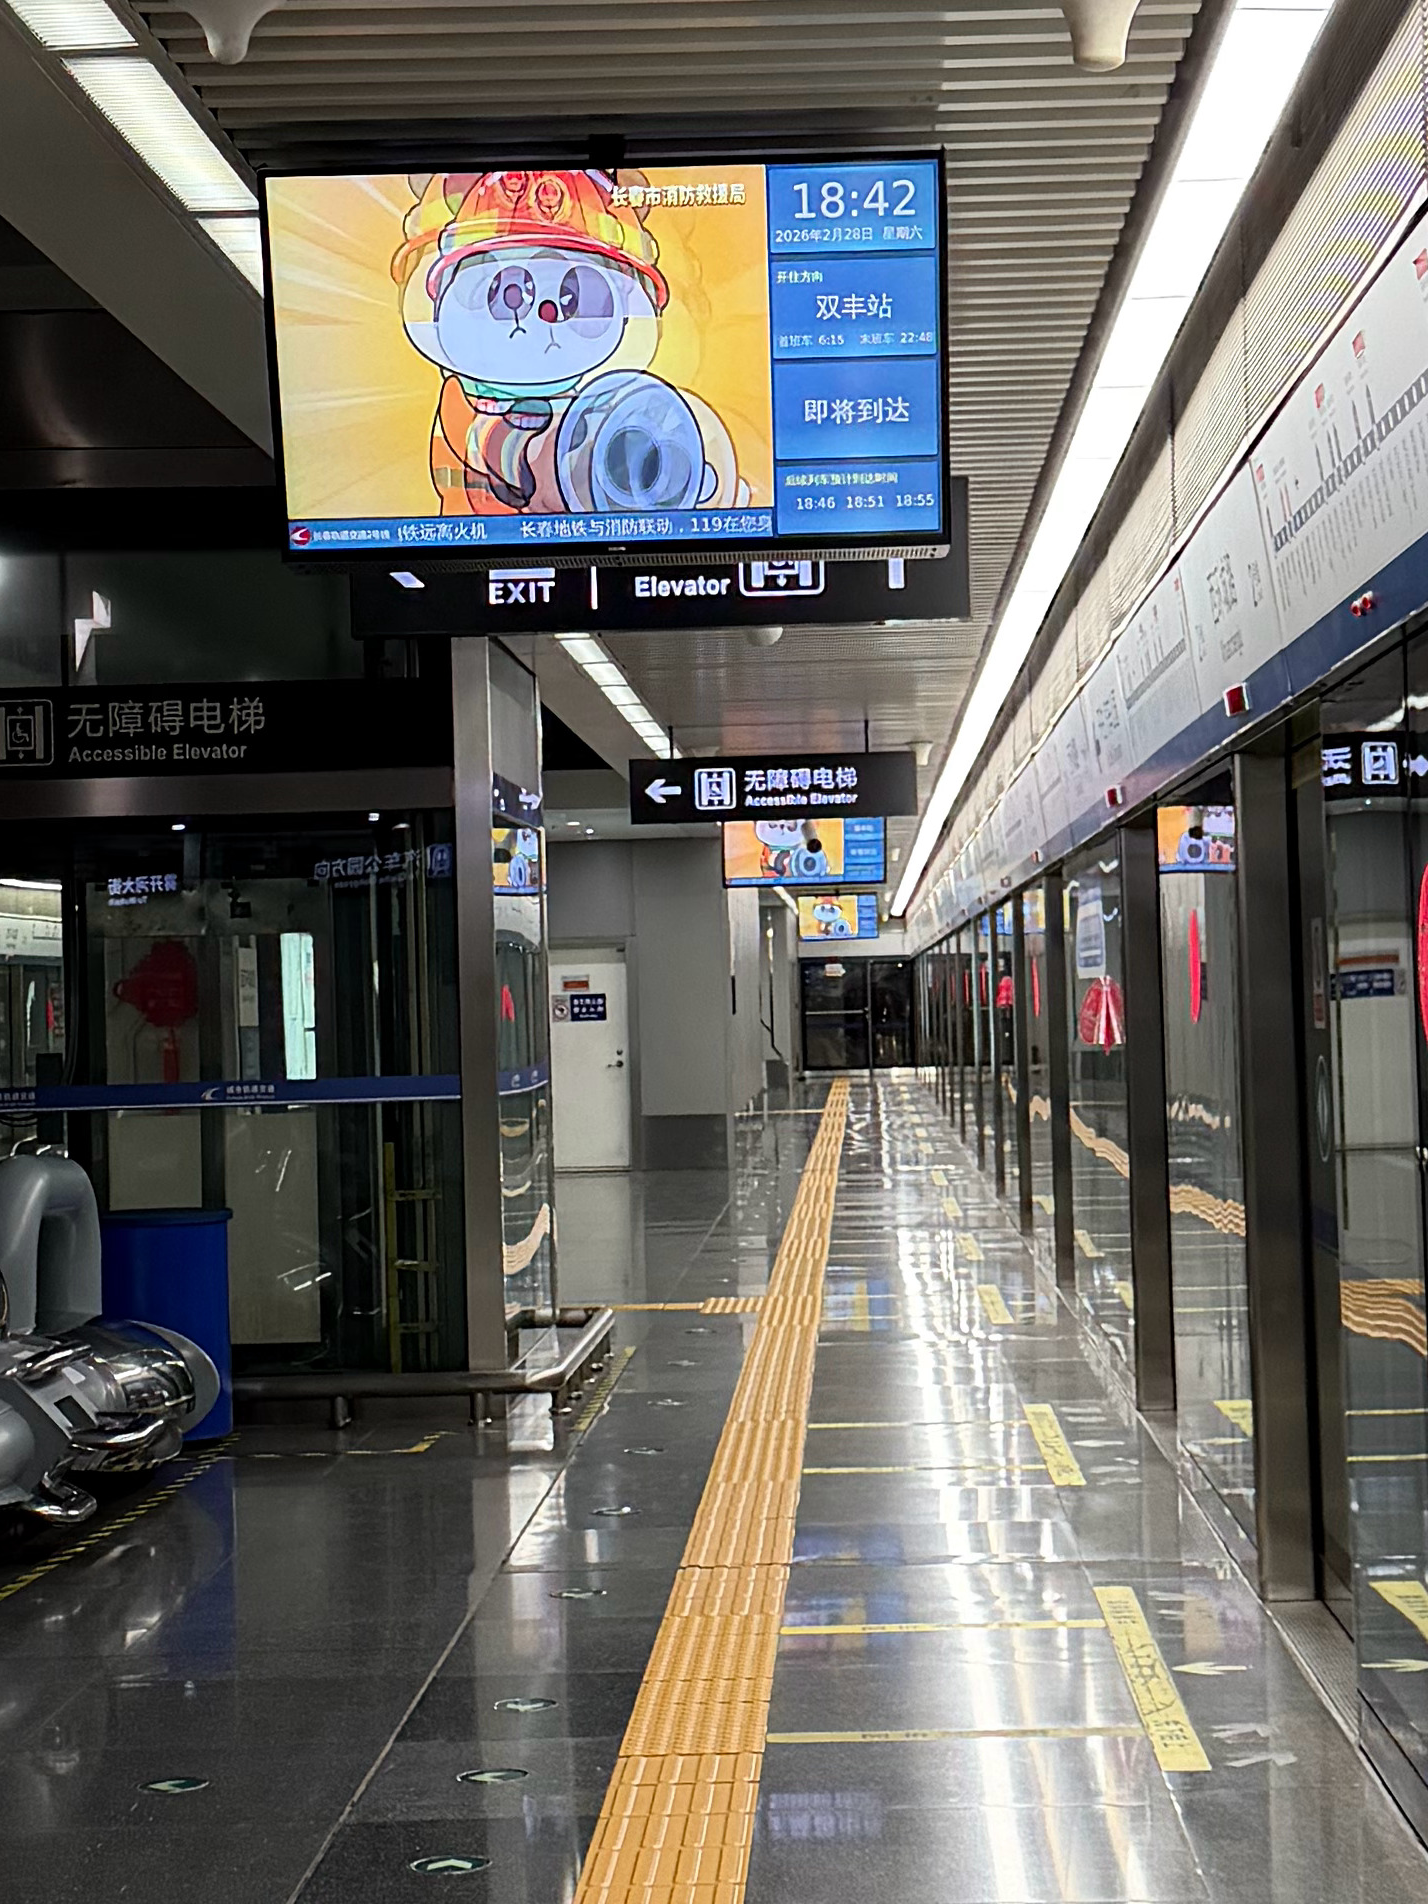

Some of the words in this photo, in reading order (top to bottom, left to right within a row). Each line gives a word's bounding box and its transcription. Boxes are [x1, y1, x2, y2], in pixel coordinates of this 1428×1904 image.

[610, 183, 746, 208] 长春市消防救援局
[793, 179, 916, 219] 18:42
[775, 226, 873, 243] 2026年2月28日
[882, 225, 923, 240] 星期六
[776, 271, 823, 284] 开往方向
[815, 292, 893, 321] 双丰站
[818, 334, 845, 345] 6:15
[900, 331, 934, 344] 22:48
[804, 396, 910, 424] 即将到达
[796, 496, 836, 510] 18:46
[846, 495, 885, 509] 18:51
[896, 493, 935, 508] 18:55
[489, 580, 556, 605] EXIT
[634, 574, 732, 599] Elevator
[67, 696, 266, 739] 无障碍电梯
[68, 744, 167, 763] Accessible
[172, 743, 248, 760] Elevator
[743, 766, 859, 792] 无障碍电梯
[744, 794, 808, 808] Accessible
[809, 791, 859, 806] Elevator
